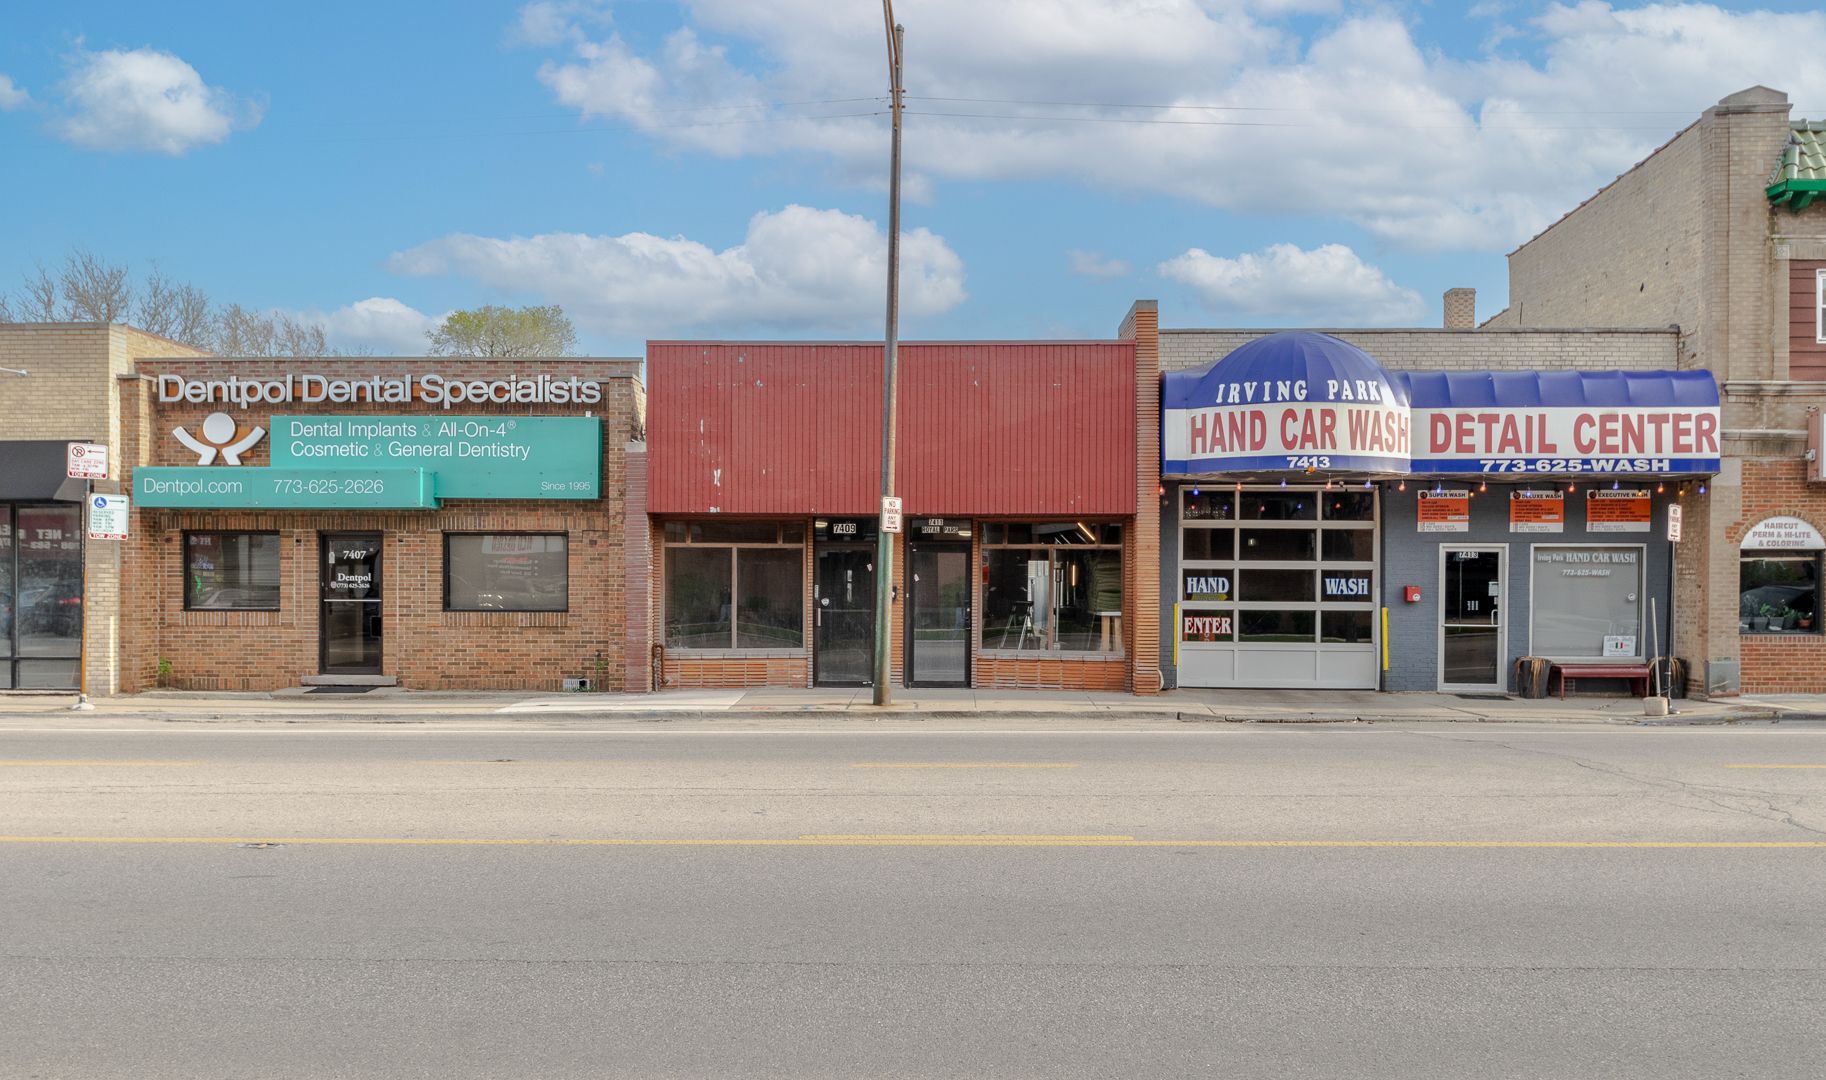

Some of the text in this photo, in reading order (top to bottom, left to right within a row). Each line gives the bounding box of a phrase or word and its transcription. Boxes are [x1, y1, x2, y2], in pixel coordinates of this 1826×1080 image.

[158, 374, 601, 409] Dentpol Dental Specialists
[1215, 379, 1383, 404] IRVING PARK
[290, 421, 342, 437] Dental
[349, 421, 417, 440] Implants
[422, 423, 432, 437] &
[1191, 408, 1409, 454] HAND CAR WASH
[1429, 413, 1719, 454] DETAIL CENTER
[290, 441, 530, 461] Cosmetic & General Dentistry
[1286, 456, 1331, 469] 7413
[1480, 459, 1670, 472] 773-625-WASH
[143, 477, 384, 497] Dentpol.com 773-625-2626
[541, 481, 591, 491] Since 1995
[833, 523, 857, 534] 7409
[343, 550, 367, 560] 7407
[1552, 553, 1564, 561] Park
[1566, 552, 1590, 563] HAND
[1592, 552, 1610, 563] CAR
[1612, 552, 1636, 564] WASH
[338, 572, 372, 584] Dentpol
[1186, 577, 1230, 594] HAND
[1325, 578, 1368, 594] WASH
[1184, 616, 1232, 634] ENTER
